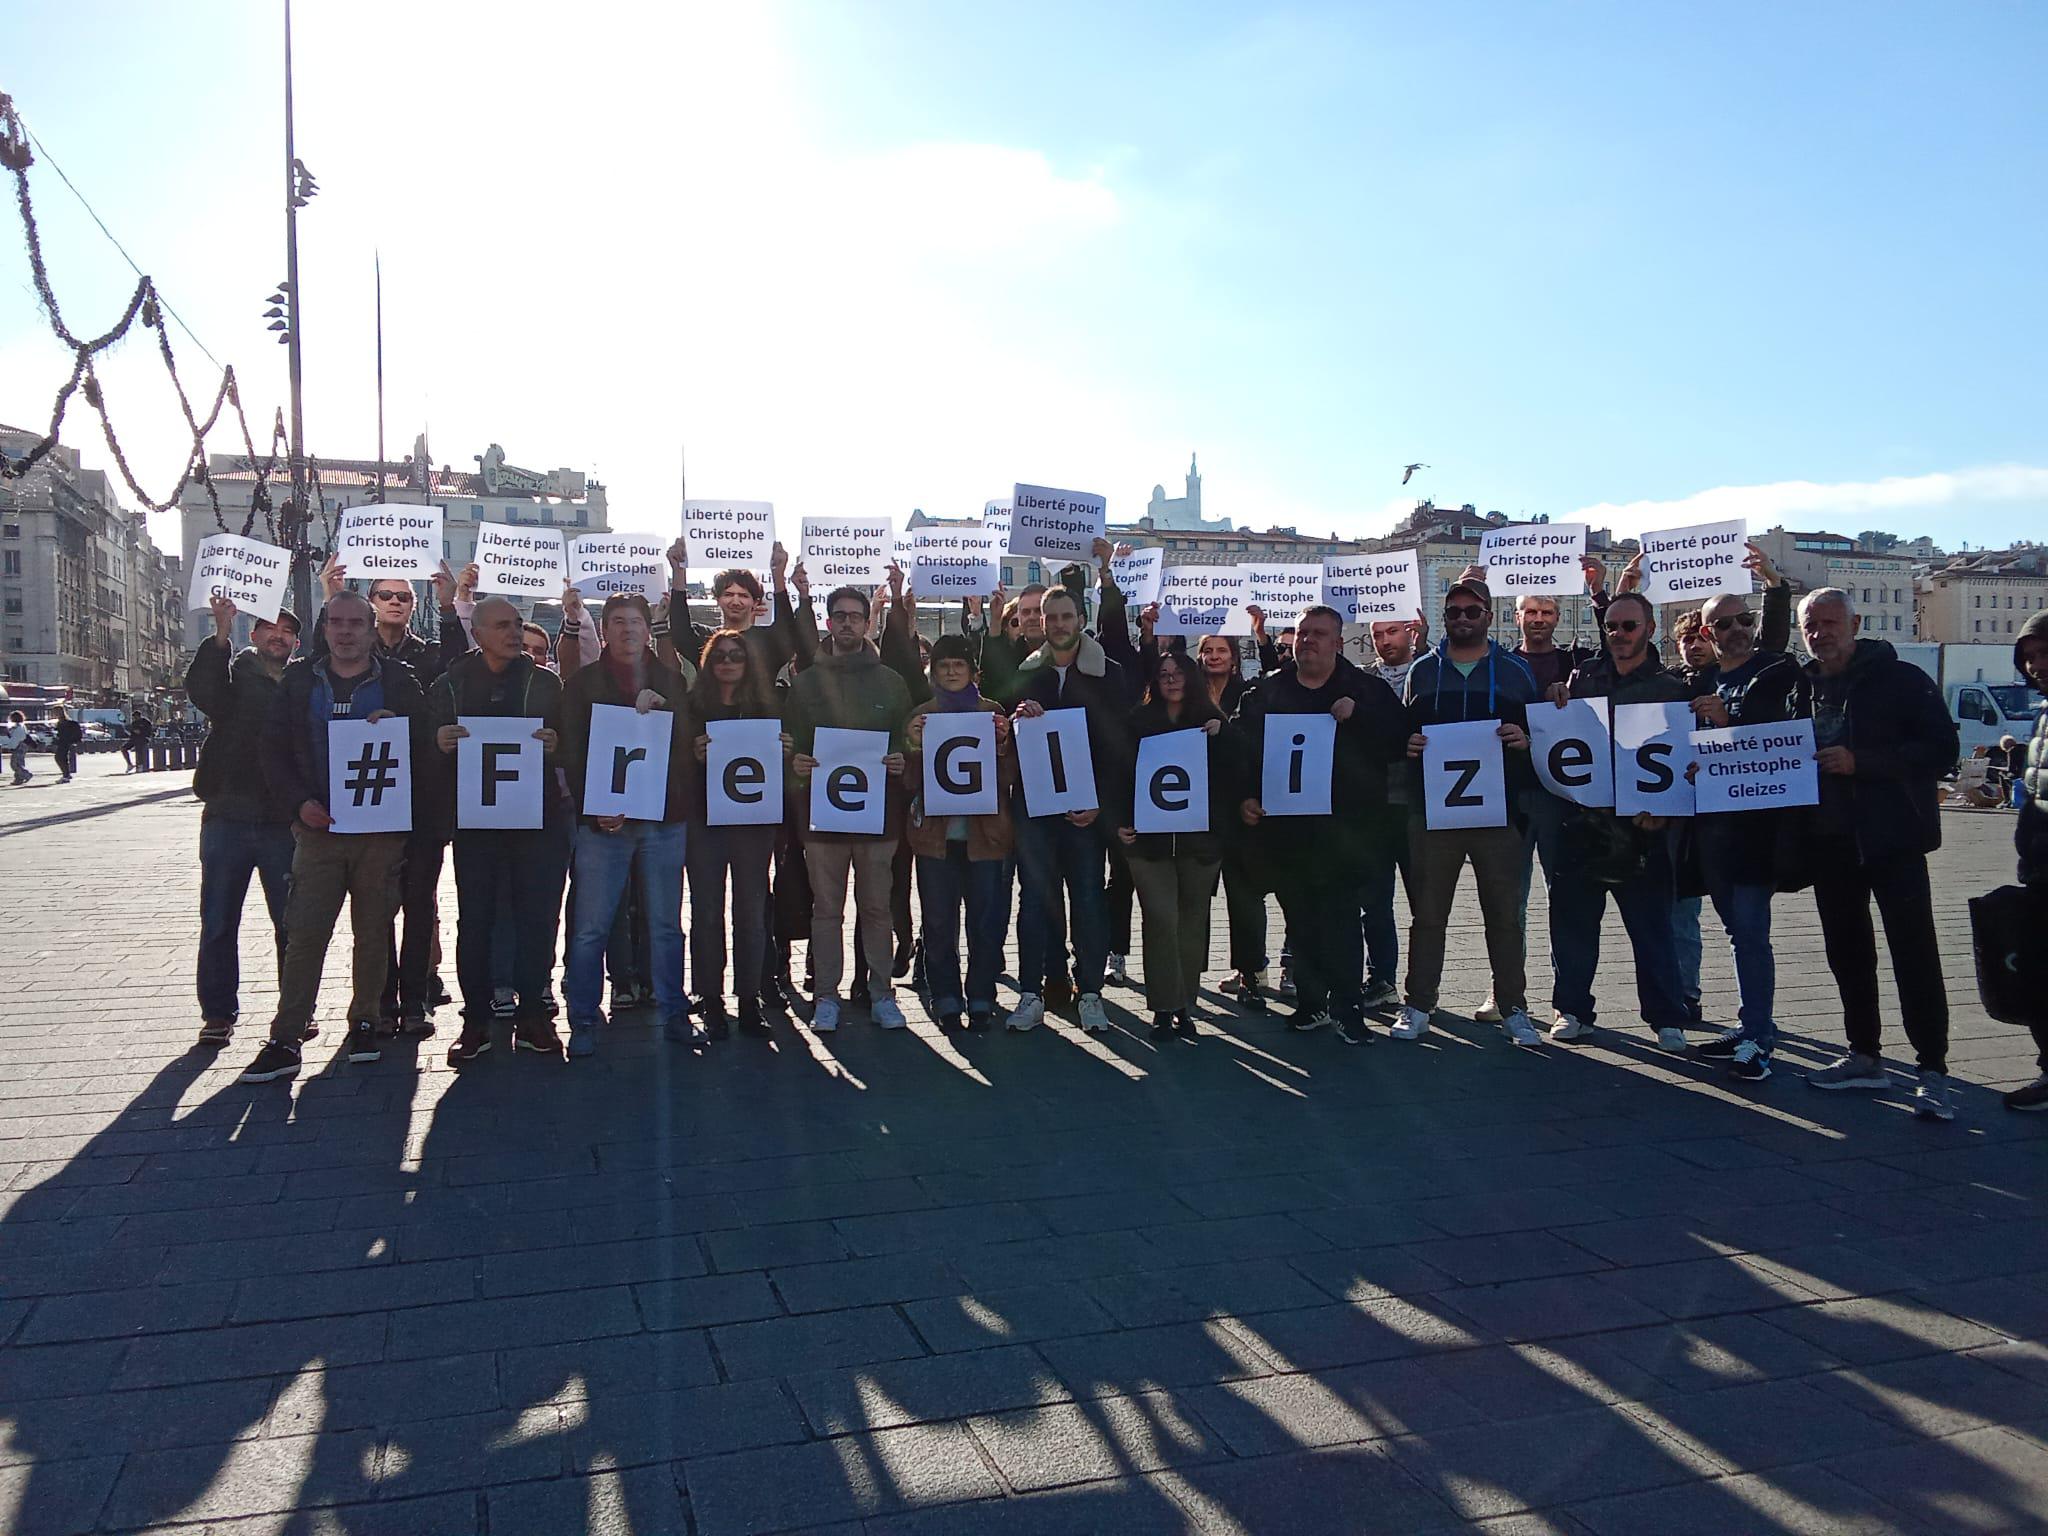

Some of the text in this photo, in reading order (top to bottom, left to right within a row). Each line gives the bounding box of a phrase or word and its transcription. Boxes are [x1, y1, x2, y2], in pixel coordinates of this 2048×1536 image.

[984, 506, 1012, 516] Liber
[1018, 496, 1100, 514] Liberté pour
[346, 514, 434, 530] Liberté pour
[686, 509, 768, 524] Liberté pour
[1021, 516, 1094, 534] Christophe
[690, 528, 764, 542] Christophe
[805, 526, 885, 540] Liberté pour
[348, 535, 428, 550] Christophe
[482, 533, 560, 552] Liberté pour
[915, 536, 958, 547] Liberté
[962, 540, 992, 550] pour
[1034, 536, 1080, 550] Gleizes
[1487, 534, 1576, 548] Liberté pour
[1643, 533, 1737, 554] Liberté pour
[202, 545, 280, 569] Liberté pour
[578, 543, 661, 557] Liberté pour
[706, 548, 752, 559] Gleizes
[808, 545, 880, 559] Christophe
[363, 556, 417, 568] Gleizes
[484, 553, 557, 571] Christophe
[917, 555, 988, 569] Christophe
[1128, 557, 1155, 570] pour
[1490, 553, 1569, 567] Christophe
[1650, 554, 1733, 572] Christophe
[201, 564, 273, 587] Christophe
[582, 561, 656, 577] Christophe
[824, 564, 870, 574] Gleizes
[1327, 564, 1409, 578] Liberté pour
[498, 573, 544, 586] Gleizes
[932, 574, 976, 585] Gleizes
[1162, 575, 1243, 590] Liberté pour
[1249, 573, 1318, 586] iberté pour
[1506, 573, 1556, 585] Gleizes
[1669, 577, 1721, 590] Gleizes
[597, 580, 645, 593] Gleizes
[1332, 582, 1405, 596] Christophe
[1164, 594, 1239, 609] Christophe
[1251, 590, 1314, 605] hristophe
[1262, 608, 1298, 619] leize
[1348, 602, 1395, 614] Gleizes
[1179, 613, 1226, 625] Gleizes
[1698, 735, 1803, 754] Liberté pour
[344, 731, 1674, 812] # F r e e G l e i z e s
[1708, 757, 1801, 776] Christophe
[1728, 782, 1786, 798] Gleizes
